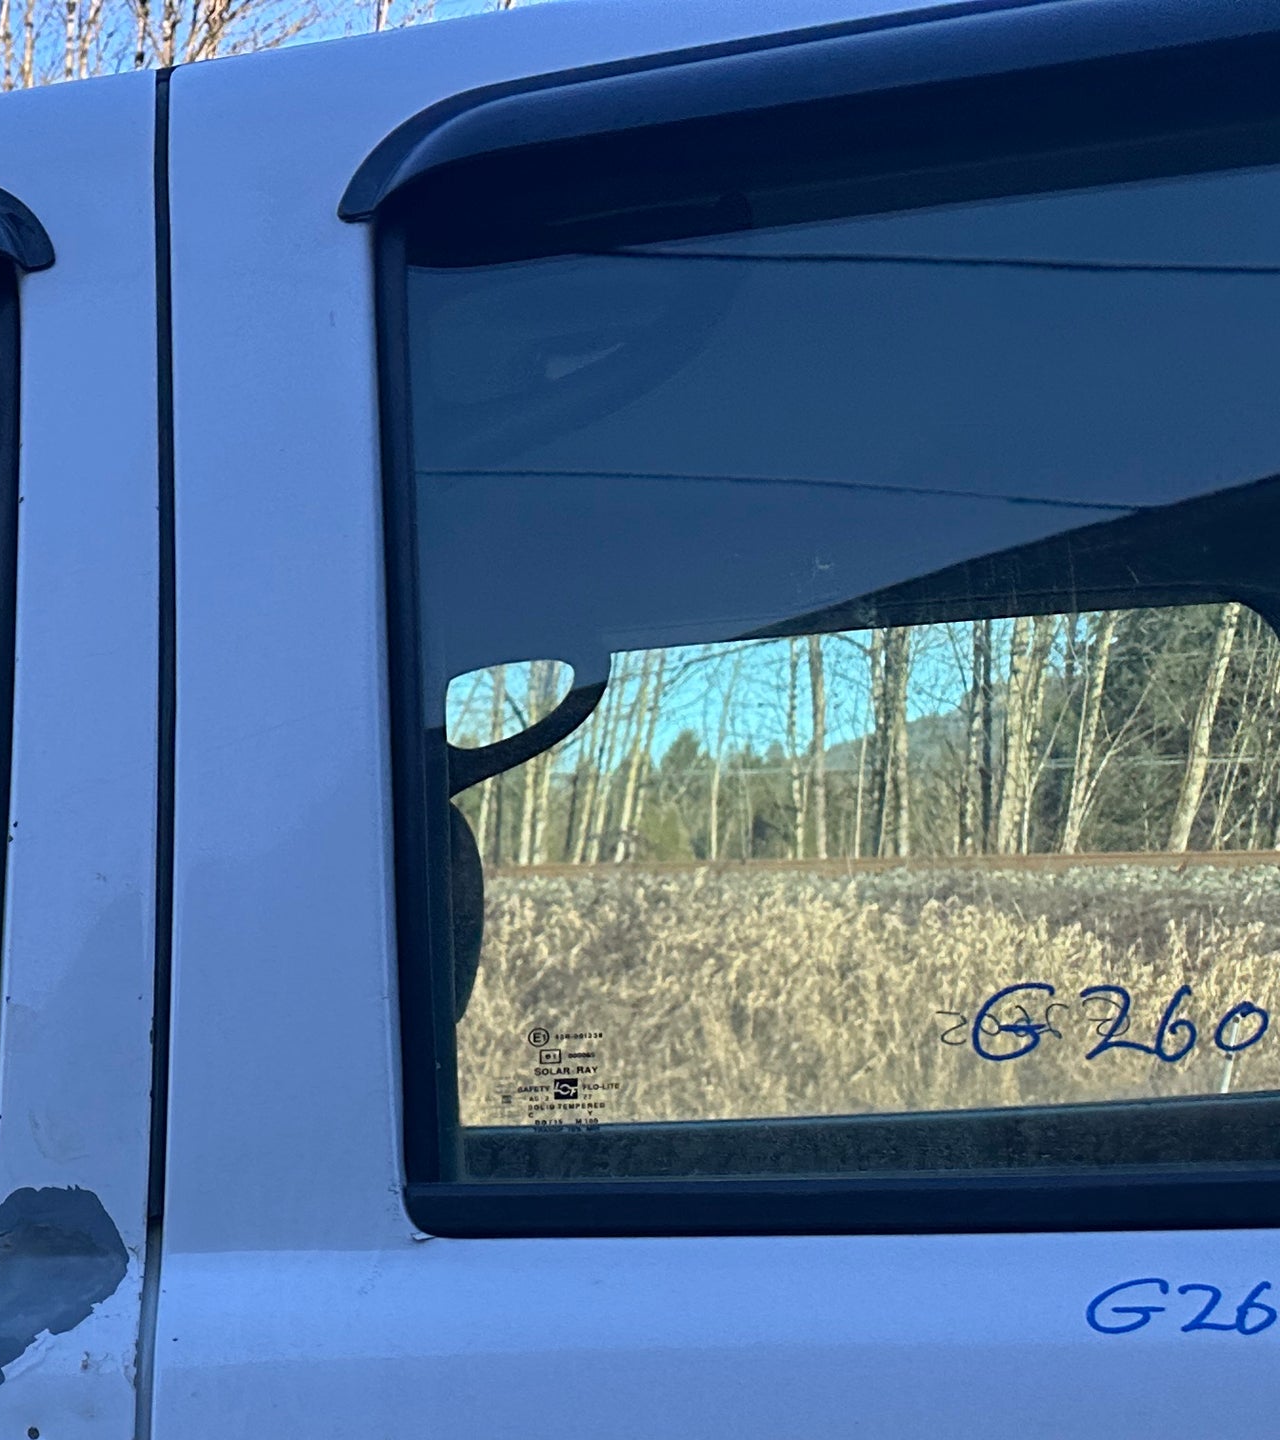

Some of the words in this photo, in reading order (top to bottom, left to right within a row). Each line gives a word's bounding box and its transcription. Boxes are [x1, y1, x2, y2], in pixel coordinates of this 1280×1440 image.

[534, 1067, 570, 1076] SOLAR
[576, 1066, 598, 1074] RAY
[517, 1085, 550, 1093] SAFETY
[582, 1083, 620, 1091] FLO-LITE
[557, 1102, 605, 1110] TEMPERED
